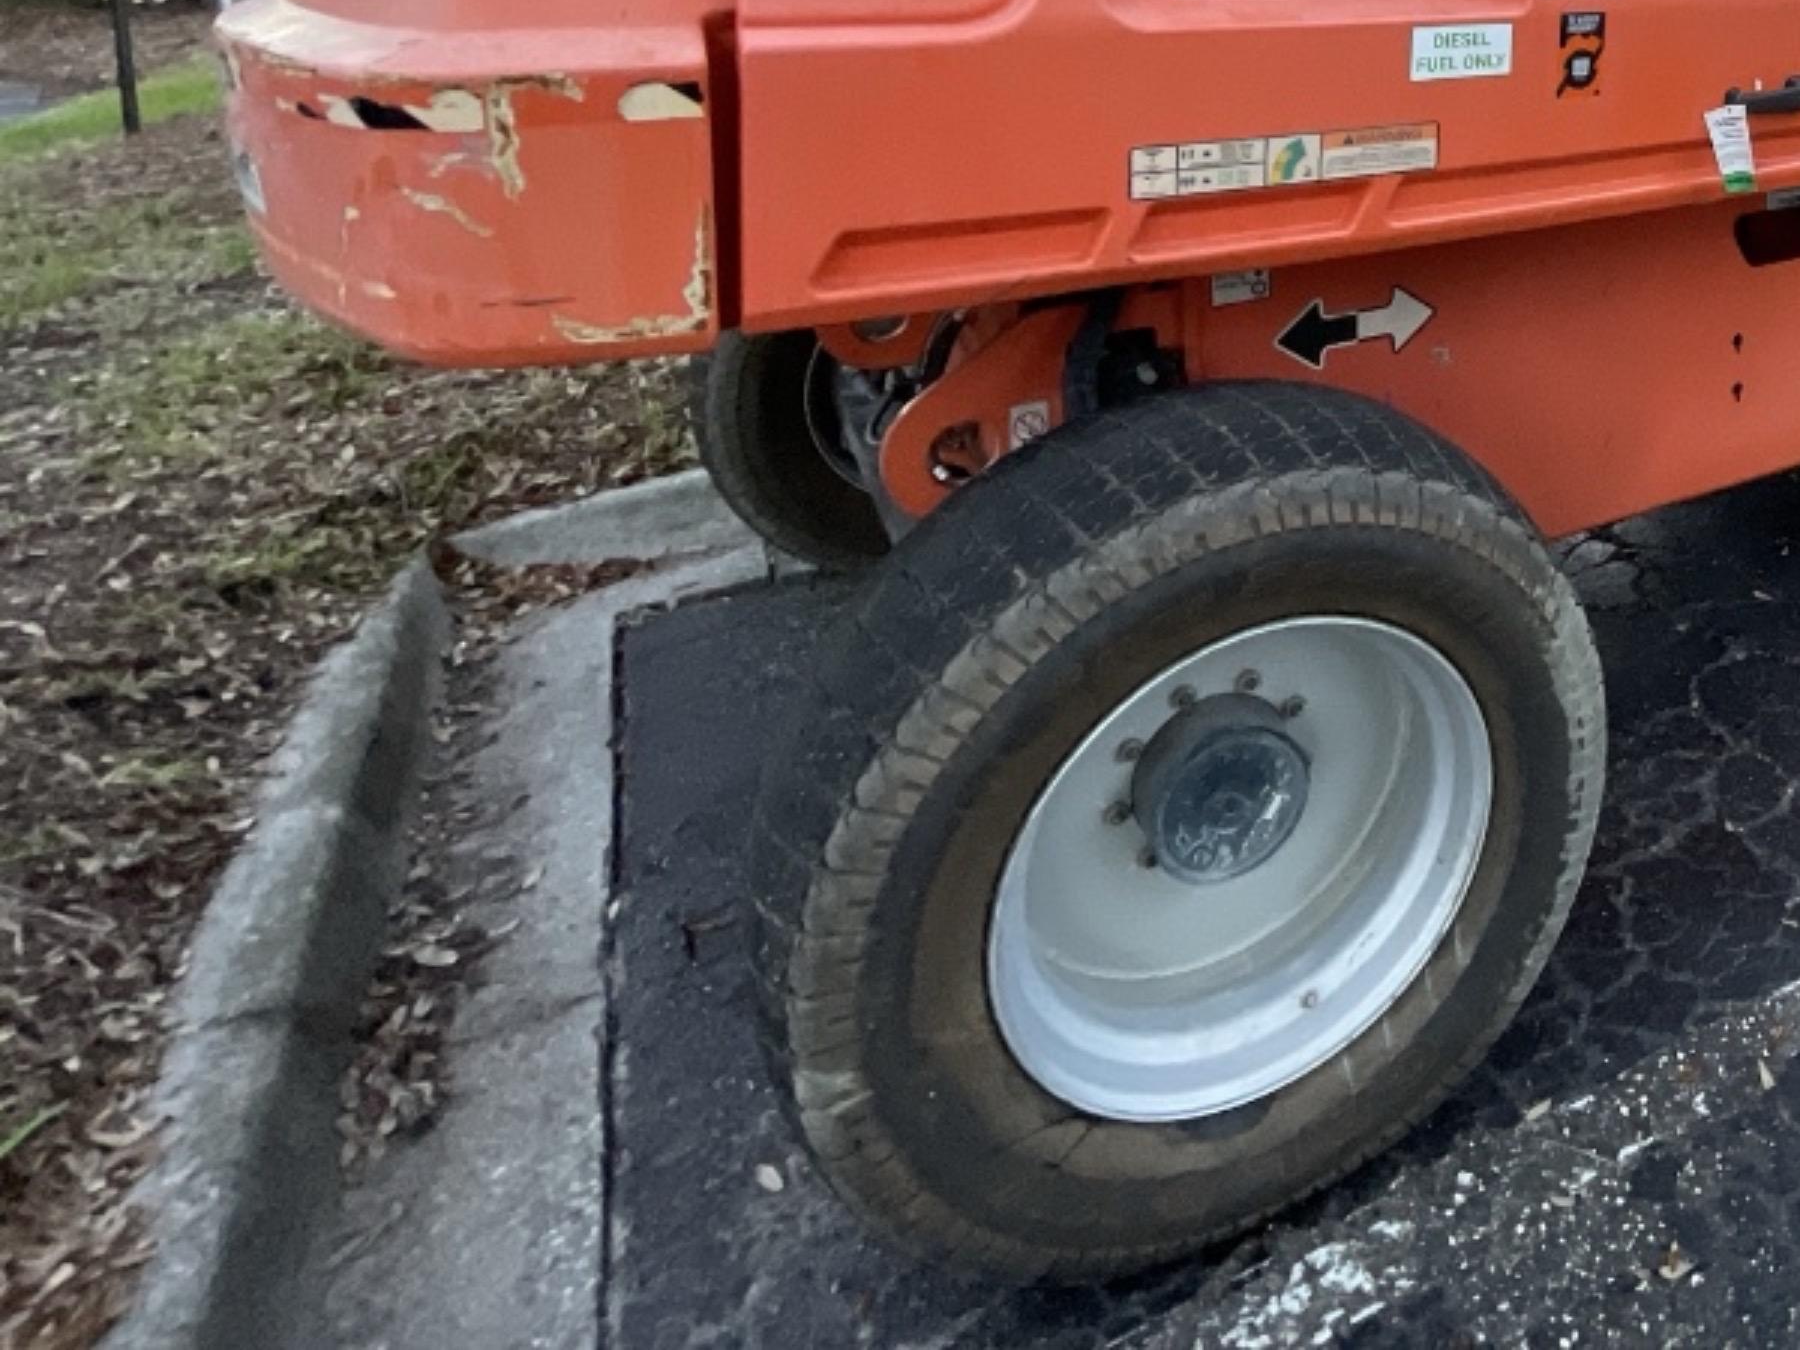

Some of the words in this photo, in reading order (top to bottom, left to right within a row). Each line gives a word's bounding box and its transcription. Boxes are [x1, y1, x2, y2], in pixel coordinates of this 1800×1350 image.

[1433, 32, 1492, 49] DIESEL
[1415, 56, 1458, 73] FUEL
[1463, 53, 1506, 70] ONLY
